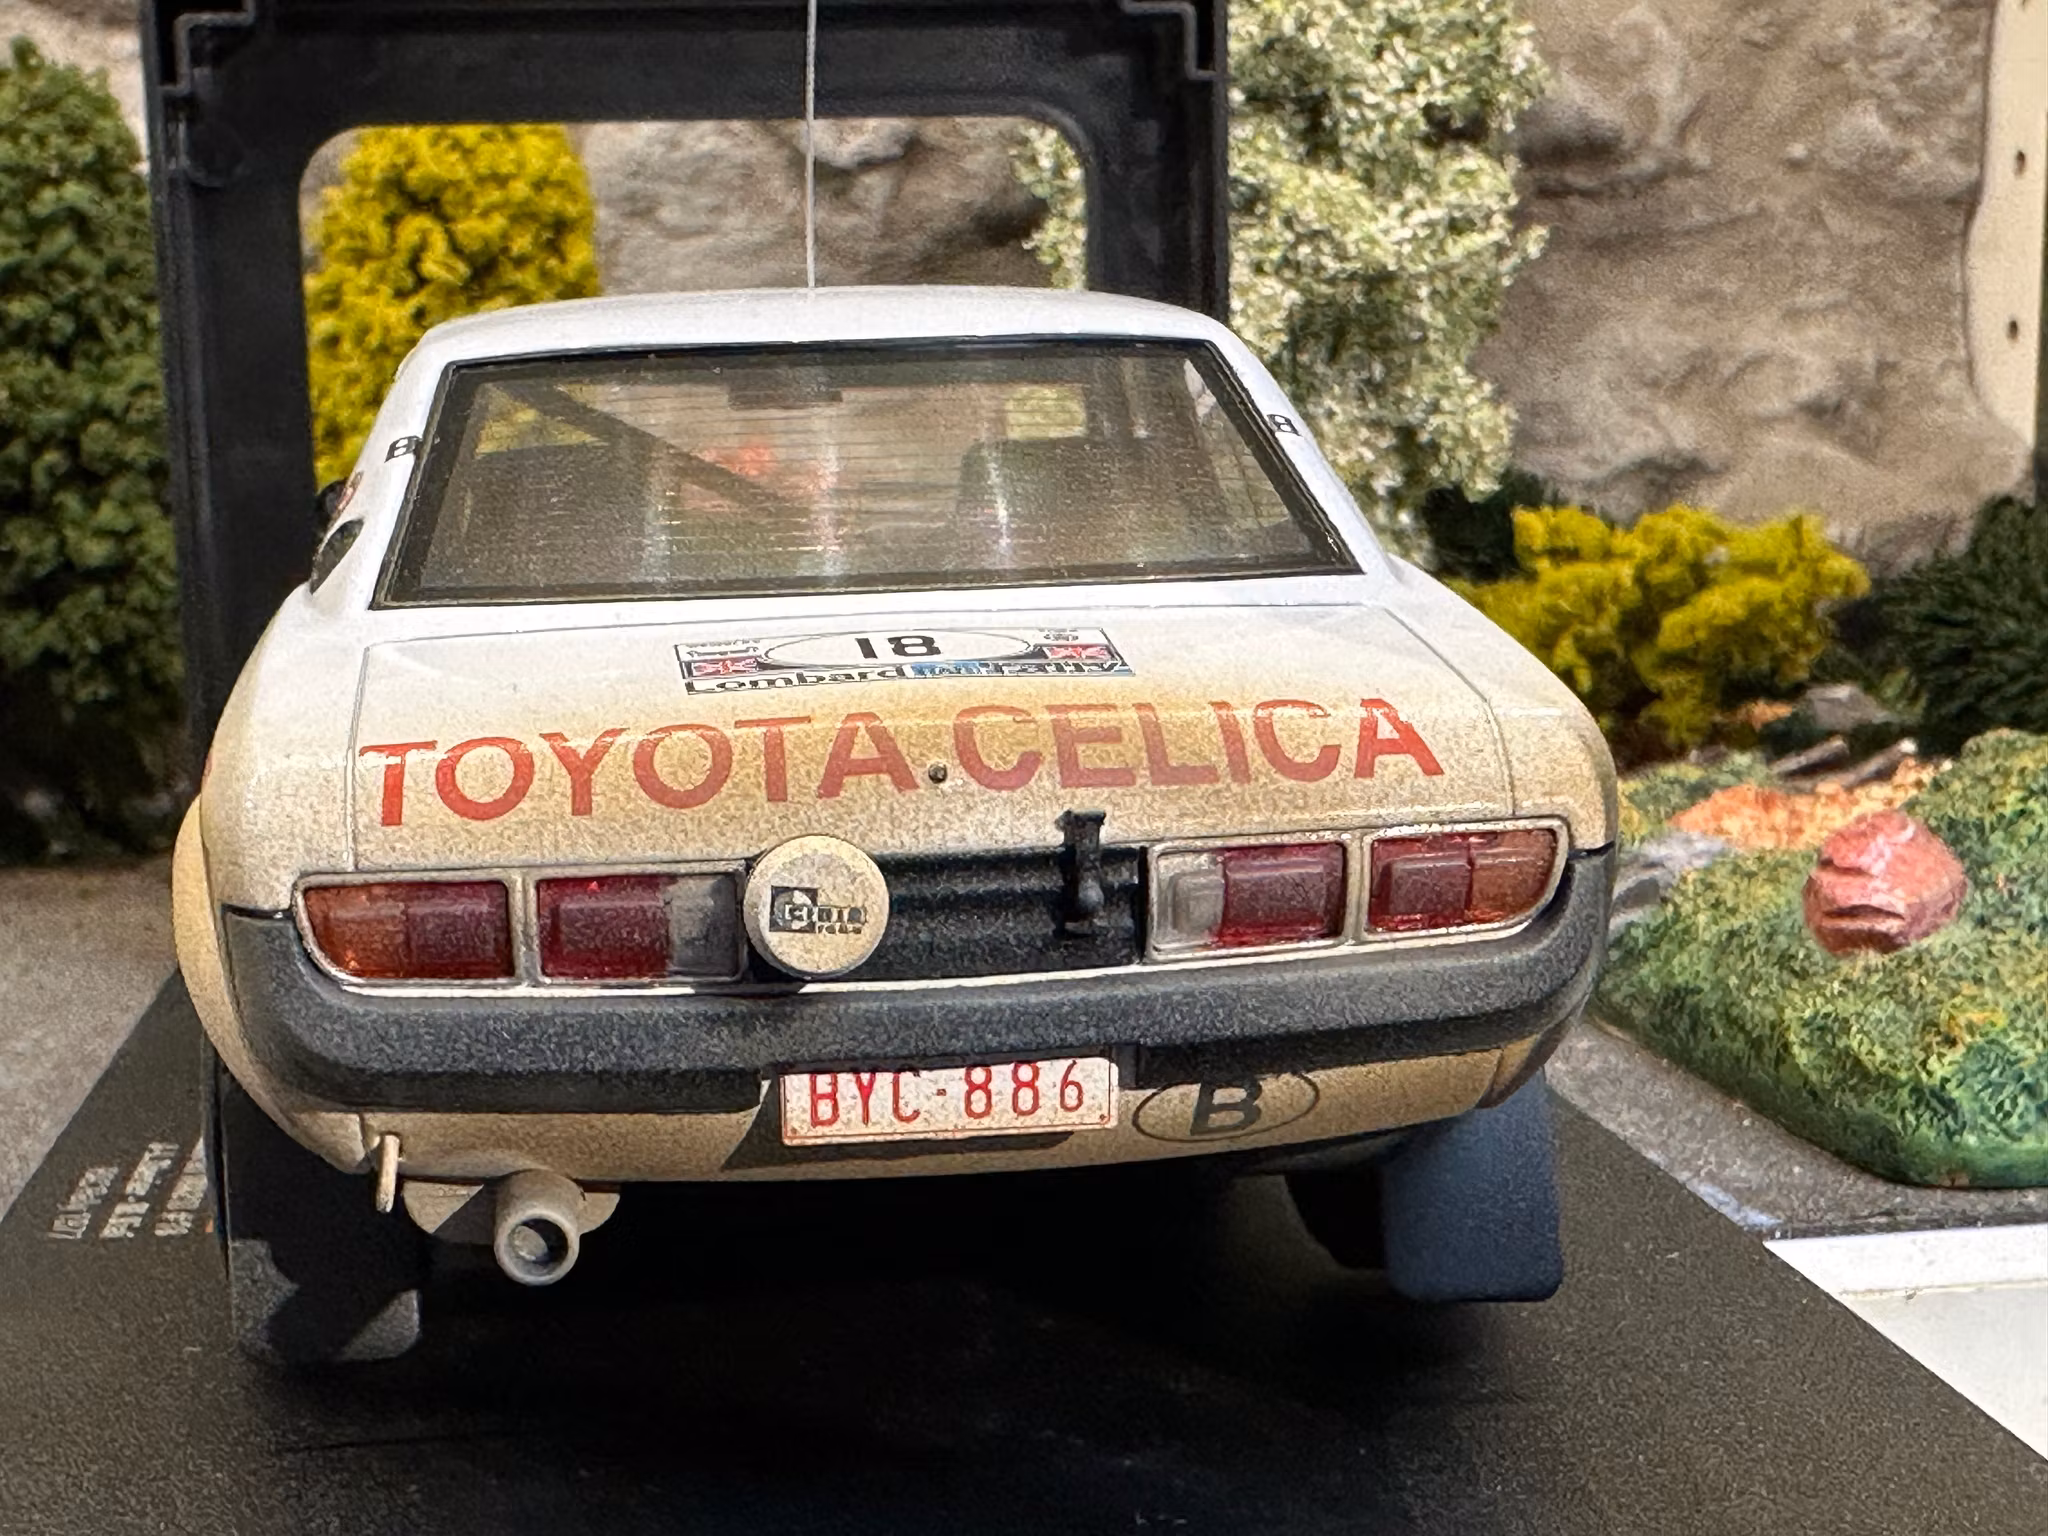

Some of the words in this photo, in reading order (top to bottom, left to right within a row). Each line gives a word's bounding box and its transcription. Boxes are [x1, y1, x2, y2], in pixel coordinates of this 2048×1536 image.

[854, 632, 941, 658] 18
[686, 663, 906, 695] Lombard
[358, 711, 918, 827] TOYOTA
[952, 697, 1445, 791] CELICA
[809, 1060, 1083, 1128] BYC-886
[1189, 1080, 1262, 1136] B
